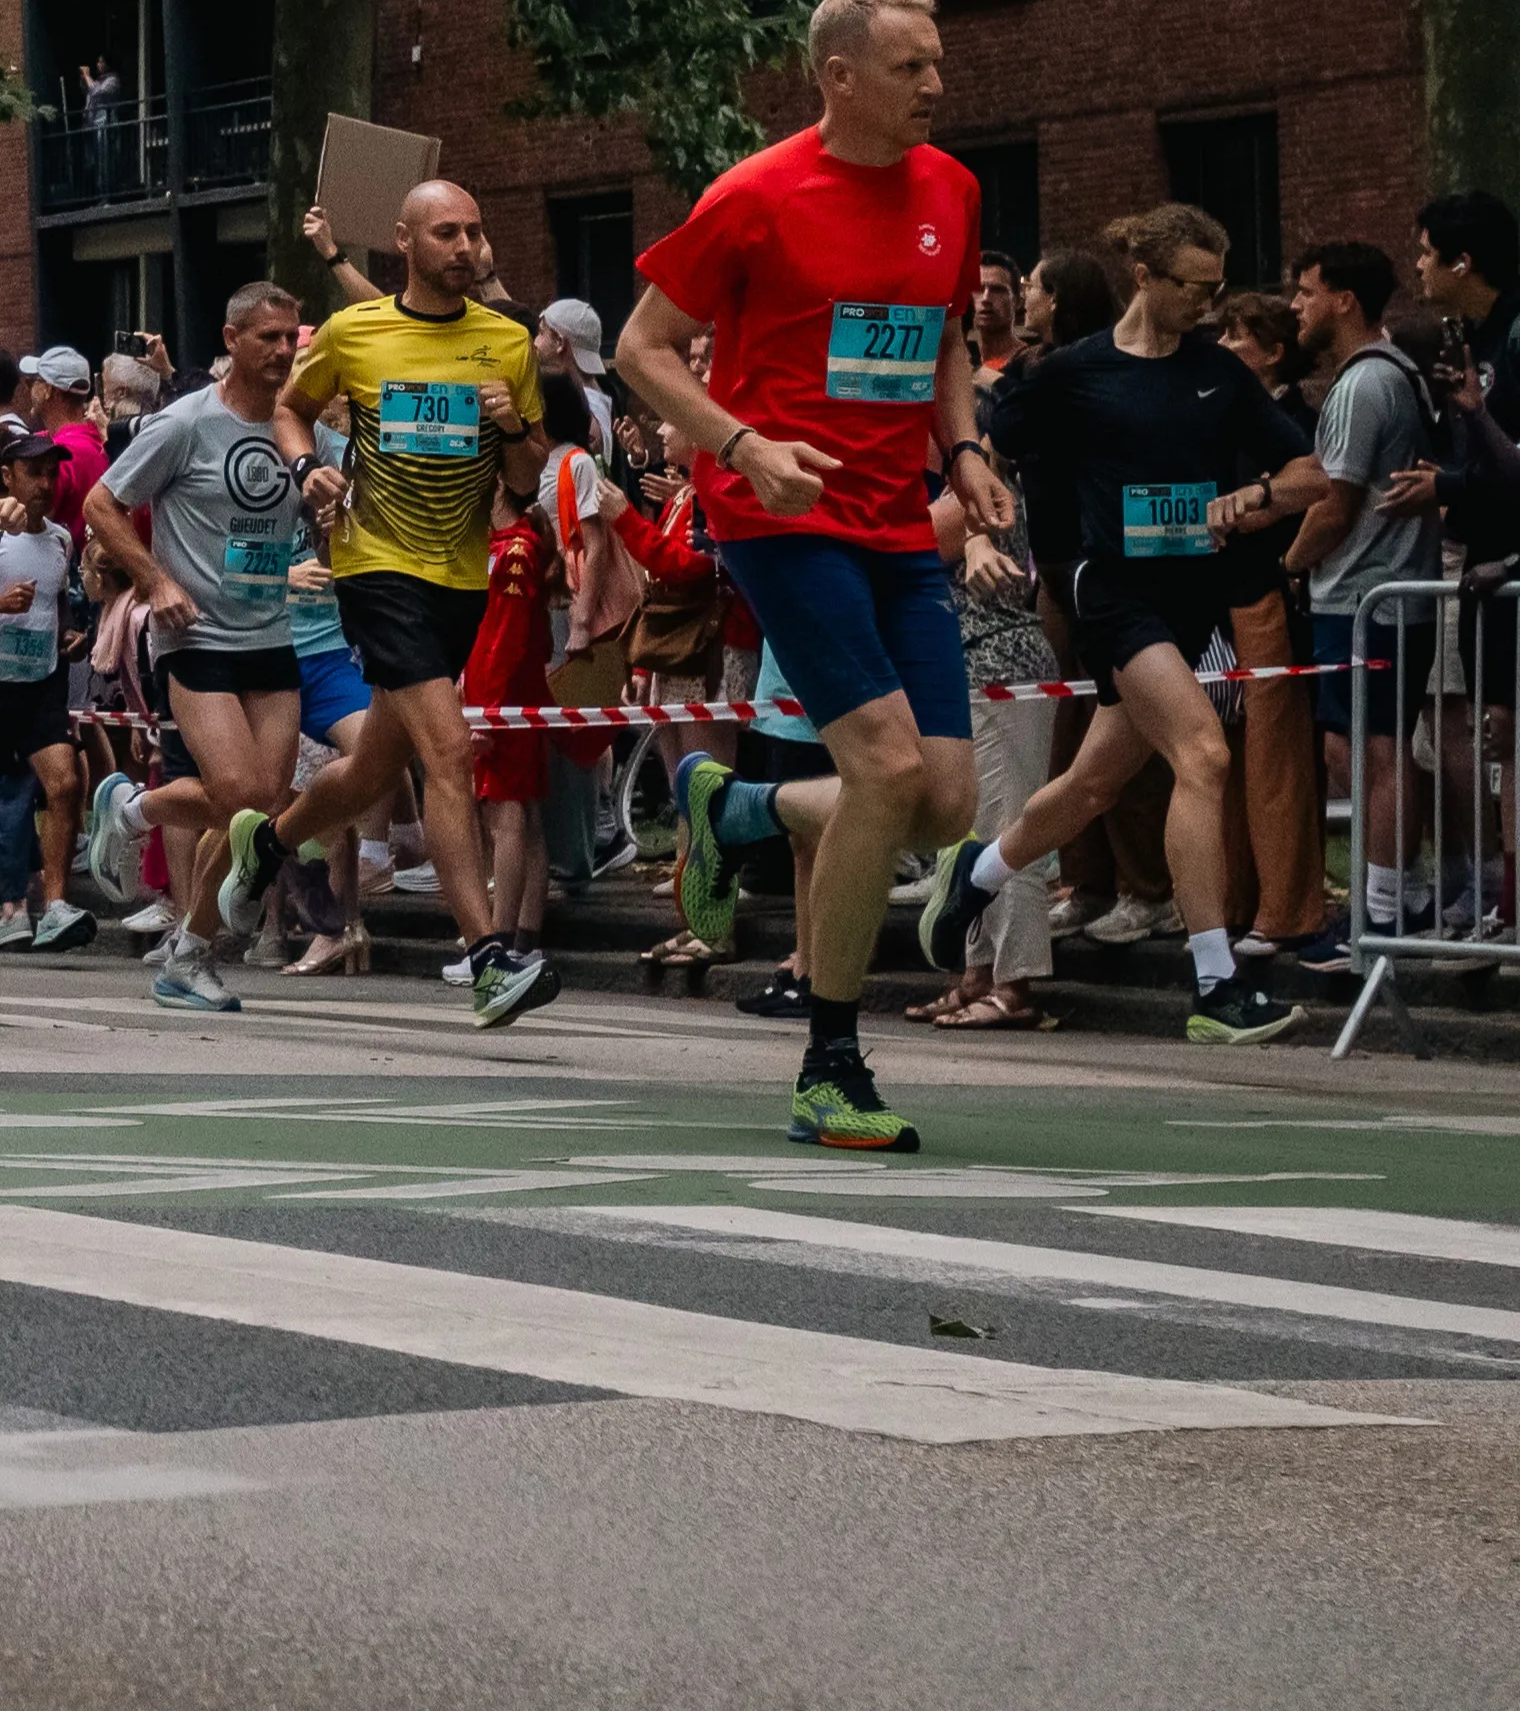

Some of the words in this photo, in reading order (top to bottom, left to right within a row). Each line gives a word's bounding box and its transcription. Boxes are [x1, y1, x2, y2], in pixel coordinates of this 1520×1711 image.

[864, 323, 924, 359] 2277
[412, 396, 449, 423] 730
[1149, 498, 1199, 525] 1003
[230, 518, 277, 535] GUEUDET
[243, 552, 278, 575] 2225
